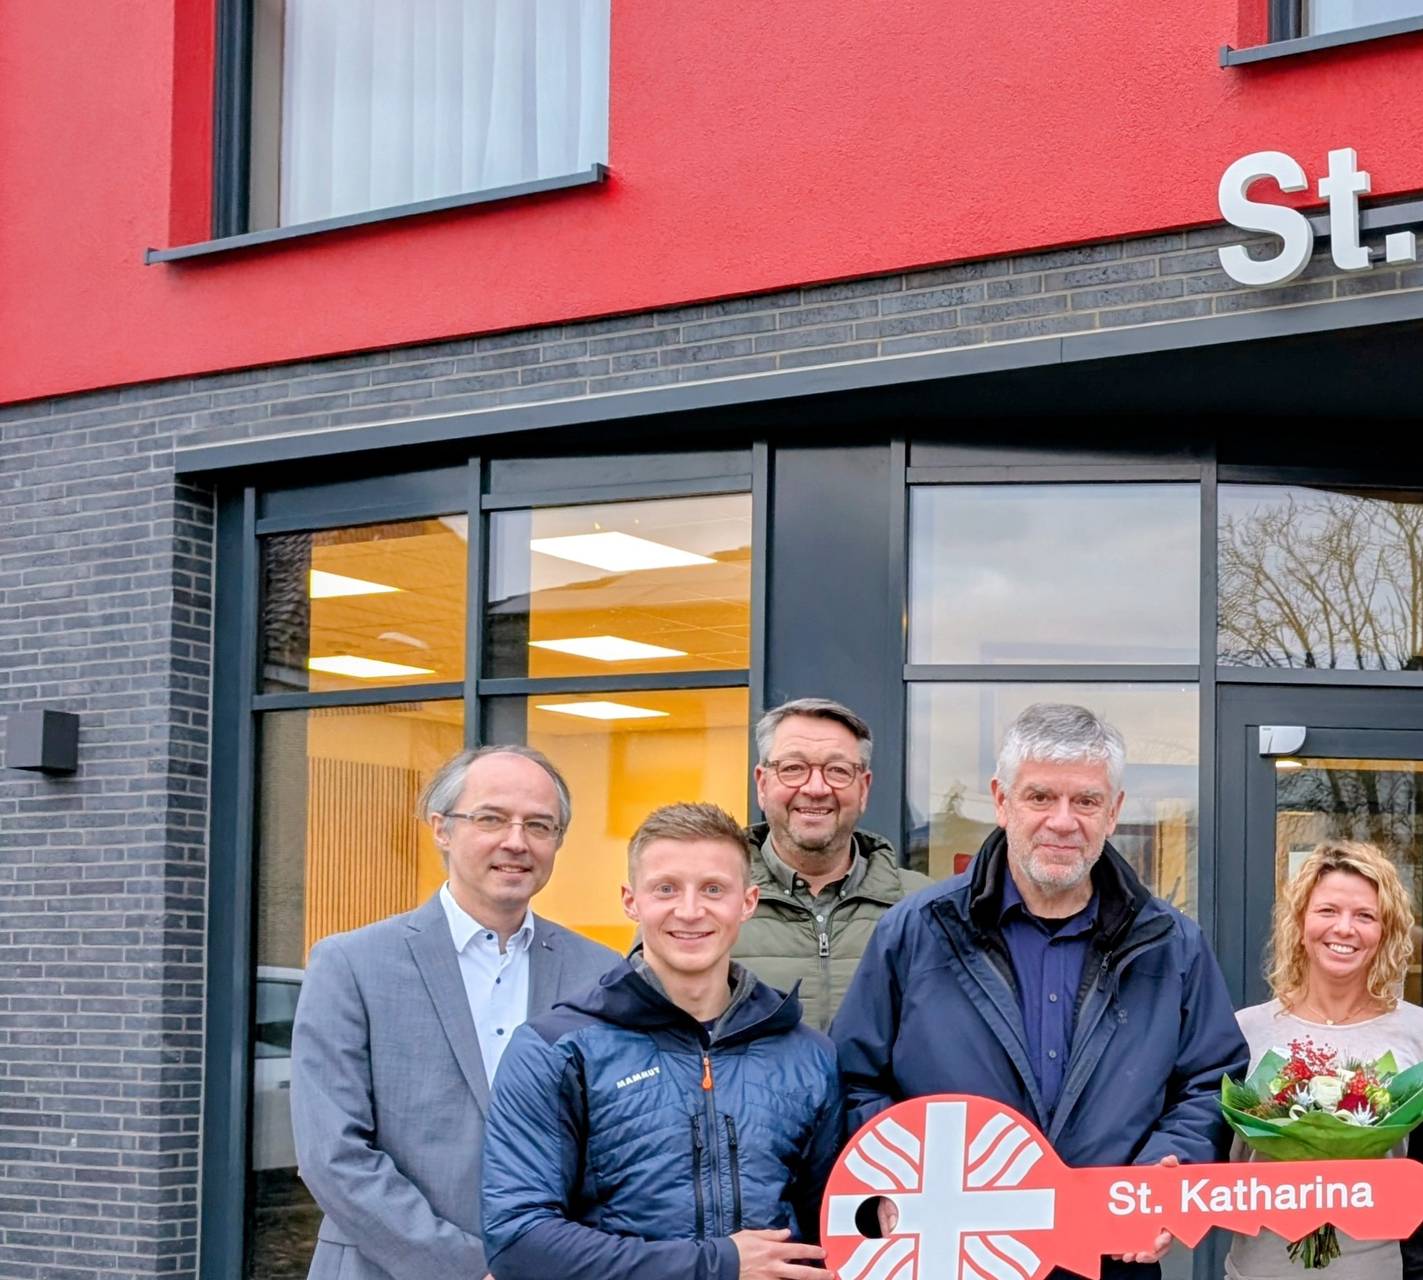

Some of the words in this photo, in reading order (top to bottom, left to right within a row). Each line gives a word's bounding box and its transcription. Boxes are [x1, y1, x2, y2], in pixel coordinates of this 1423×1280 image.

[1218, 147, 1416, 286] St.
[616, 1066, 660, 1089] MAMMUT
[1108, 1180, 1163, 1216] St.
[1180, 1175, 1374, 1213] Katharina
